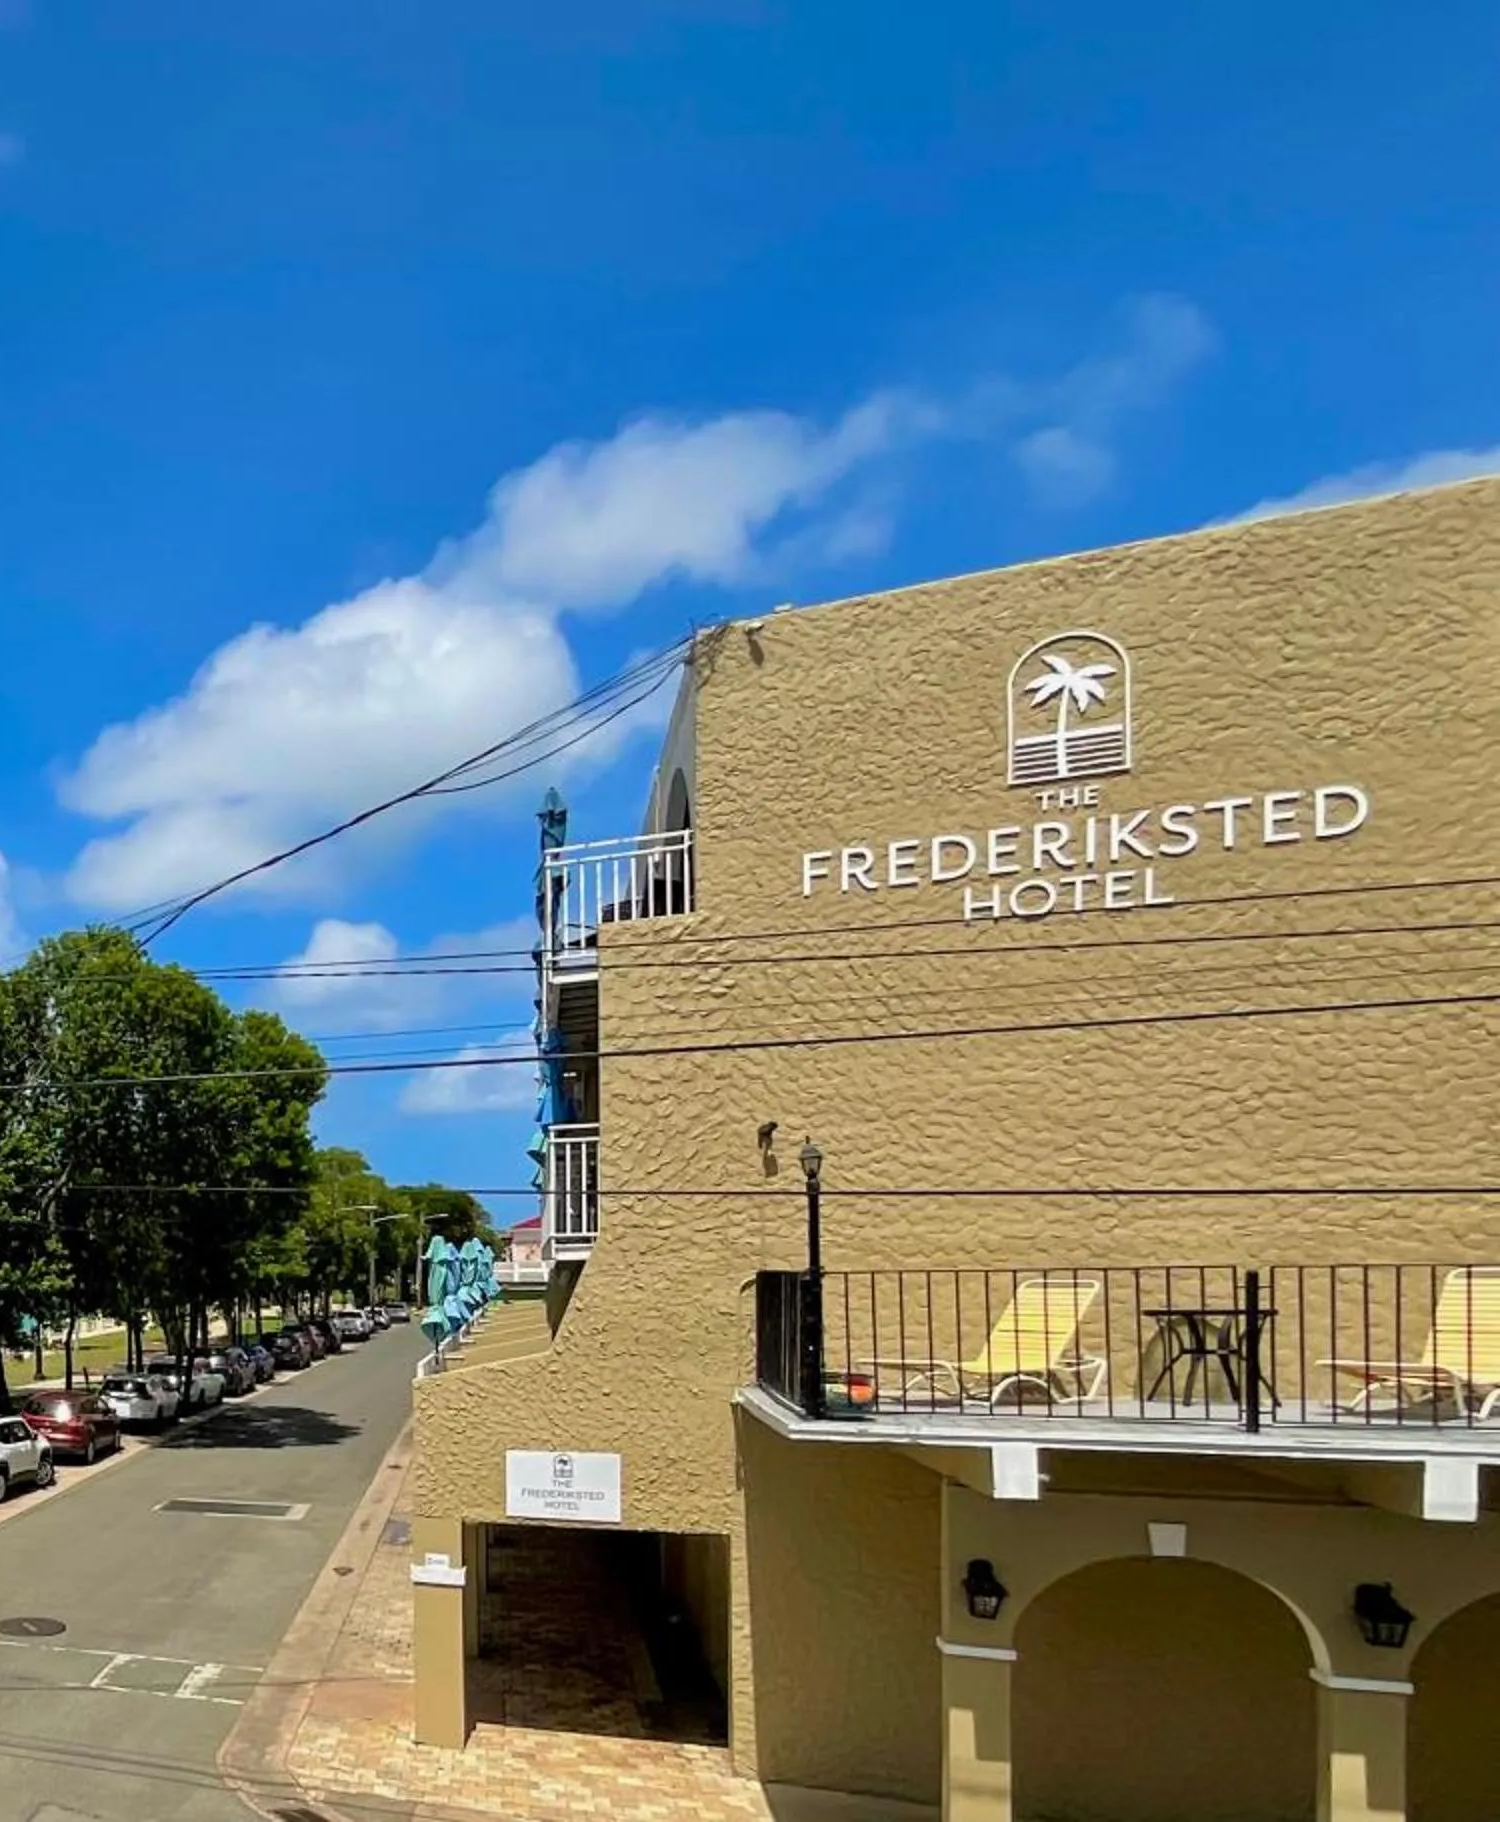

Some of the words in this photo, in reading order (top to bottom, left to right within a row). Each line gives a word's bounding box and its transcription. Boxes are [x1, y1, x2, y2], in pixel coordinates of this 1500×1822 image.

[1036, 785, 1100, 811] THE
[800, 784, 1370, 898] FREDERIKSTED
[962, 867, 1175, 922] HOTEL
[552, 1479, 574, 1489] THE
[543, 1501, 581, 1511] HOTEL
